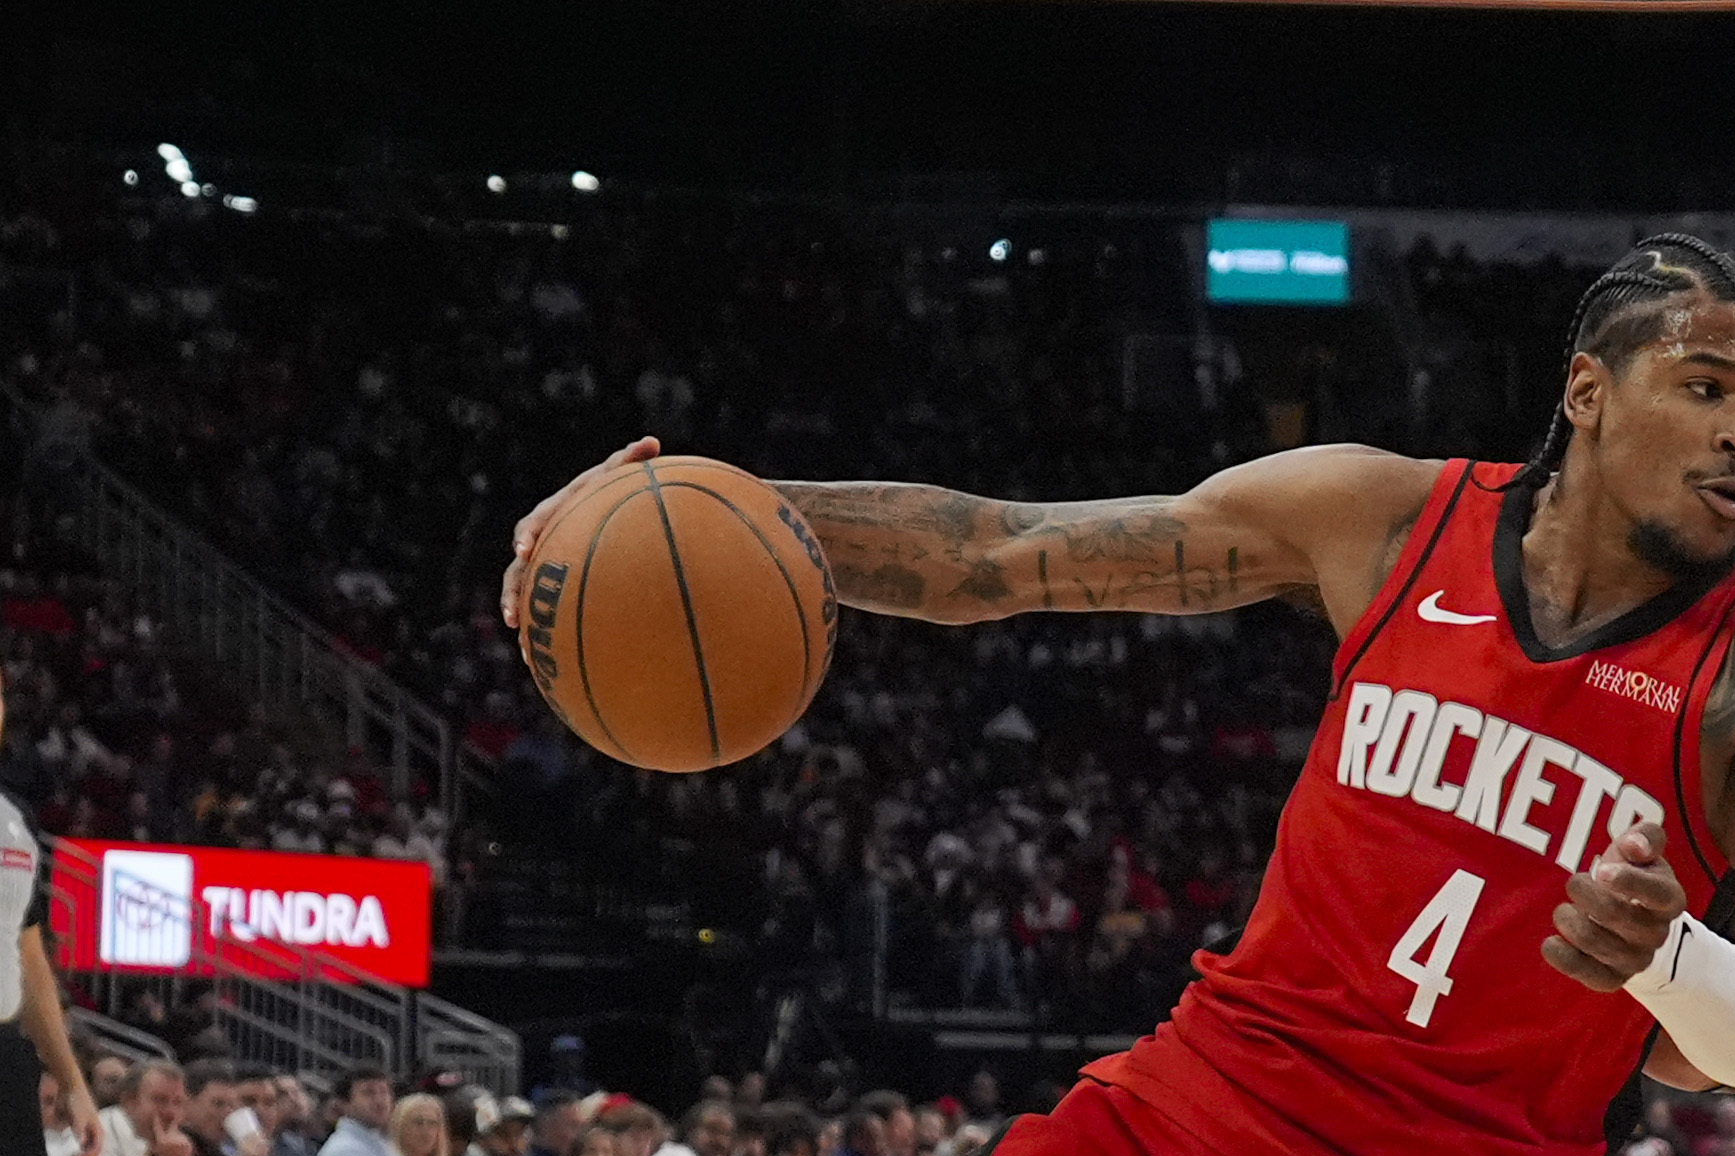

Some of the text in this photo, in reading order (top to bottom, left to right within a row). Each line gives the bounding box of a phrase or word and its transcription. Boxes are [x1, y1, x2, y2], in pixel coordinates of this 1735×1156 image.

[1585, 671, 1681, 714] HERMANN
[1590, 659, 1681, 703] MEMORIAL
[202, 885, 390, 949] TUNDRA
[1386, 868, 1486, 1029] 4
